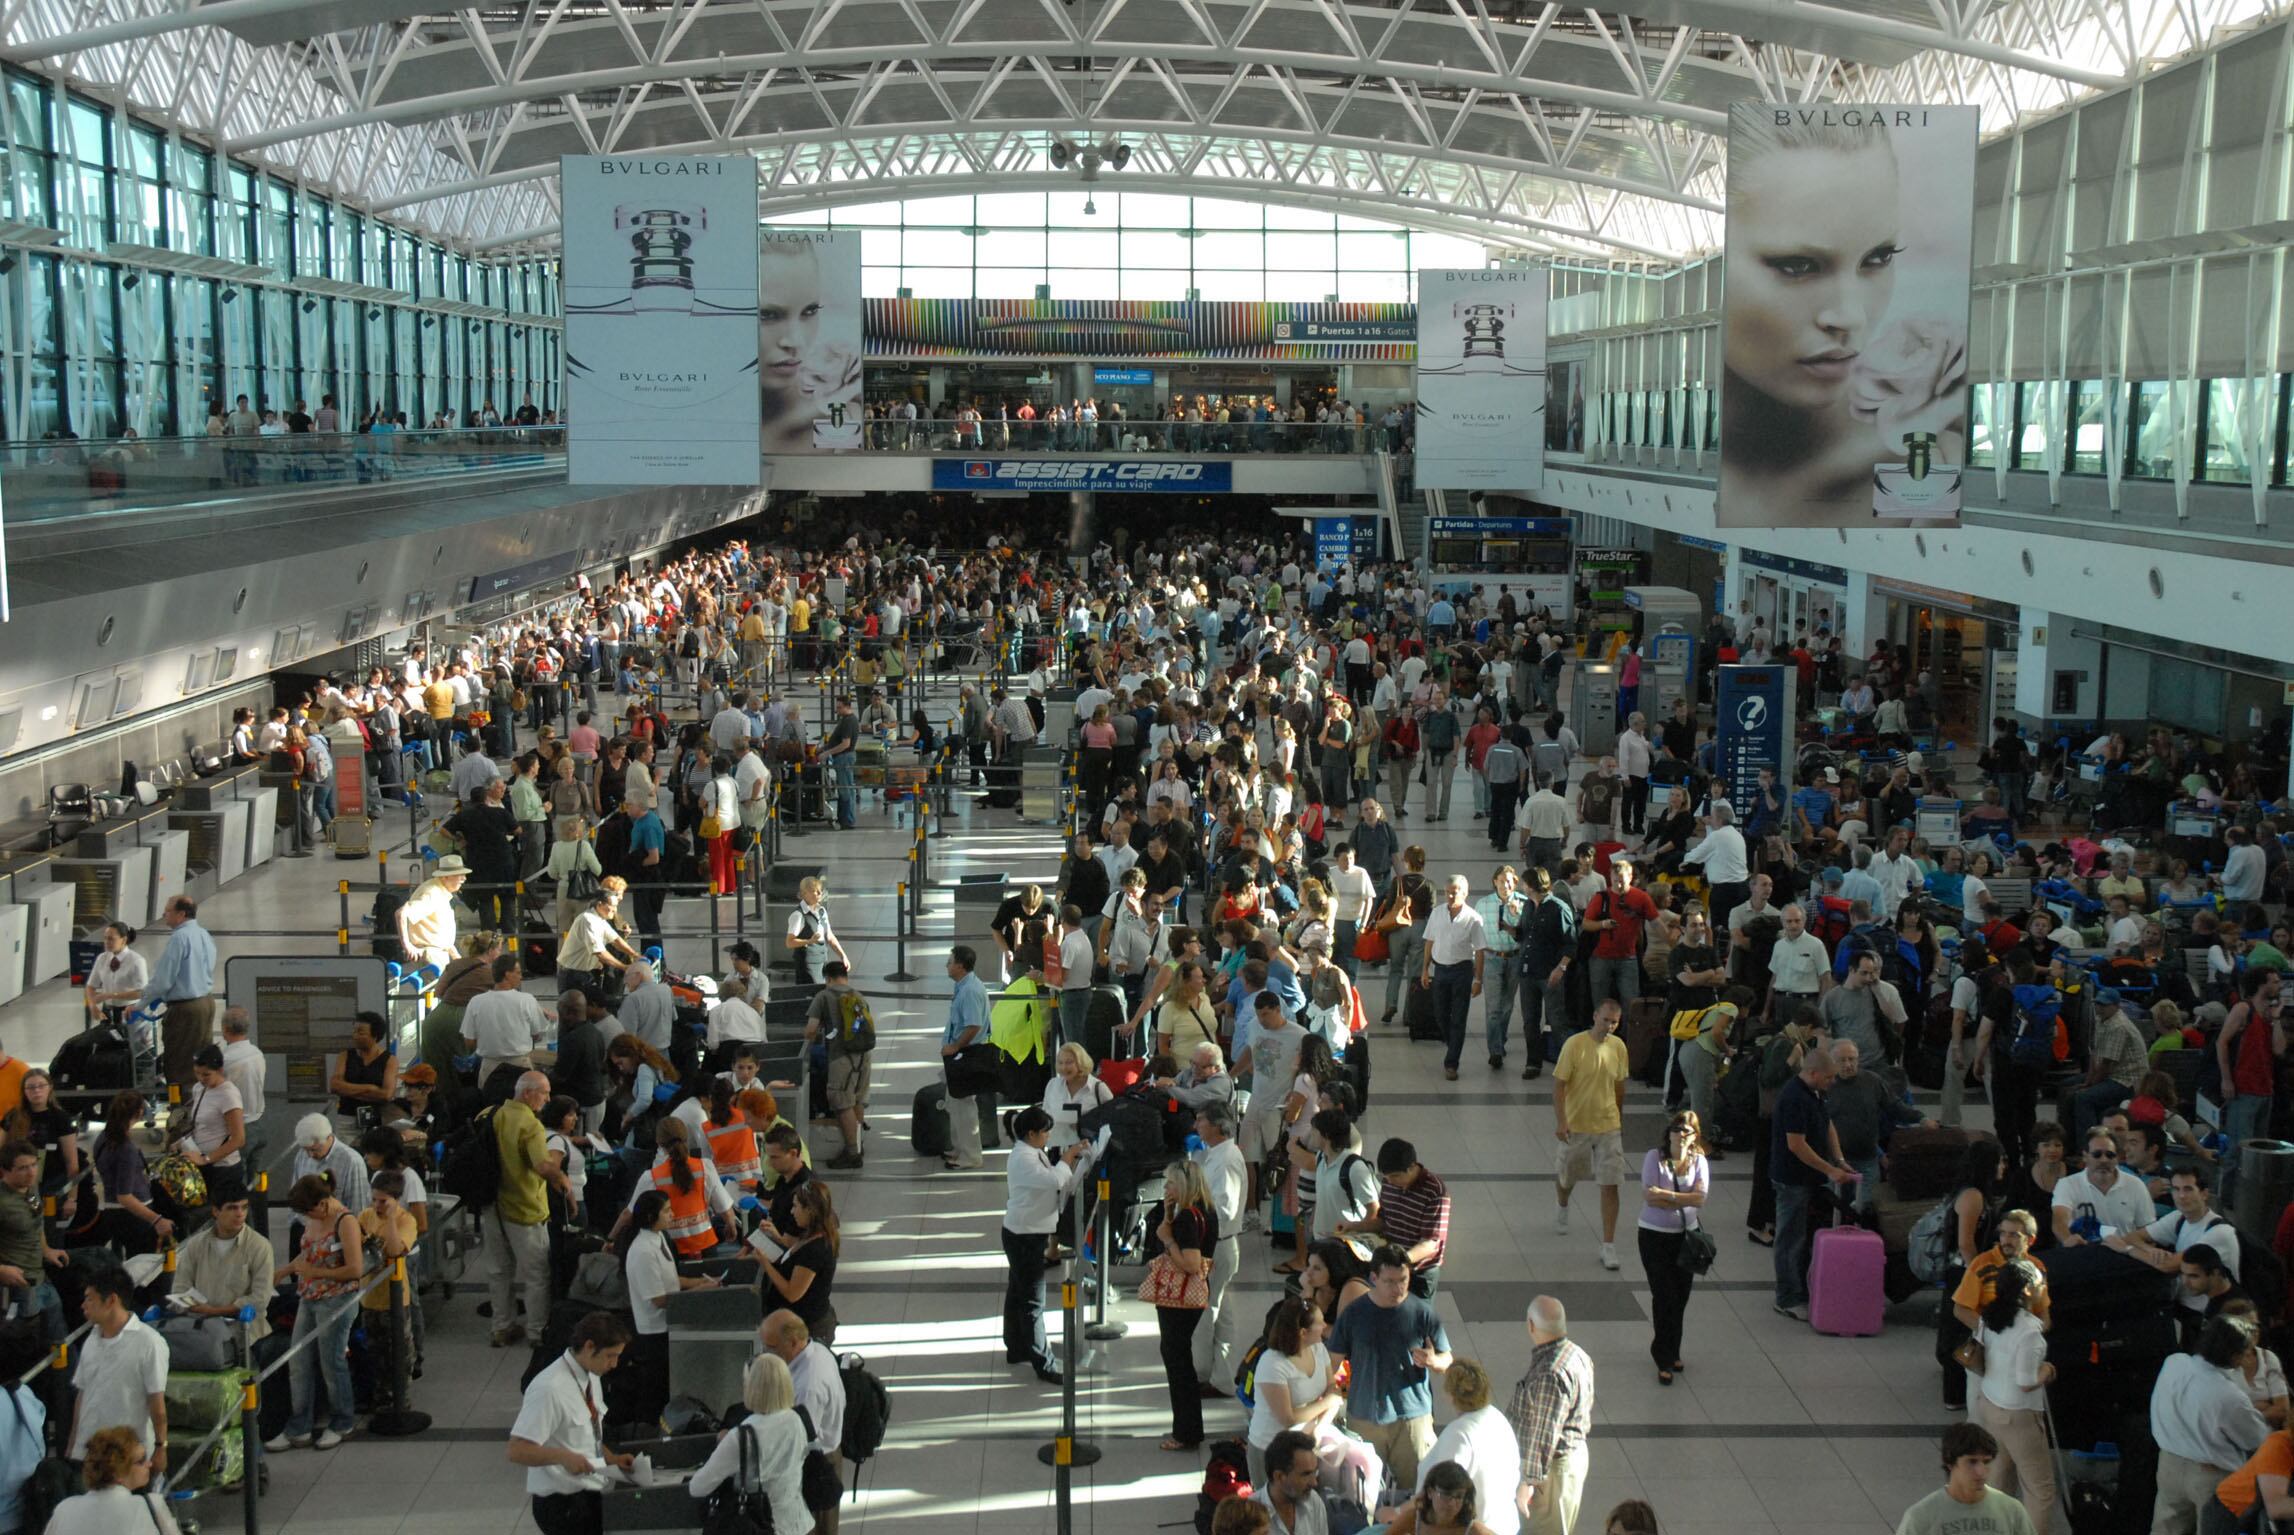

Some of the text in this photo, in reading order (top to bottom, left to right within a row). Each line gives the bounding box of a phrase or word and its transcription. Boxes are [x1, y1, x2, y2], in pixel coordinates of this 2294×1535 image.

[1774, 110, 1928, 127] BVLGARI
[600, 161, 722, 175] BVLGARI
[764, 233, 834, 243] VLGARI
[1446, 272, 1526, 281] BVLGARI
[1321, 325, 1355, 335] Puertas
[1358, 325, 1362, 335] 1
[1387, 325, 1409, 335] Gates
[620, 373, 707, 381] BVLGARI
[996, 462, 1203, 480] ASSIST-CARD
[1015, 479, 1153, 491] Imprescindible para su viaje
[1478, 521, 1512, 529] Departures
[1586, 551, 1633, 561] TrueStar
